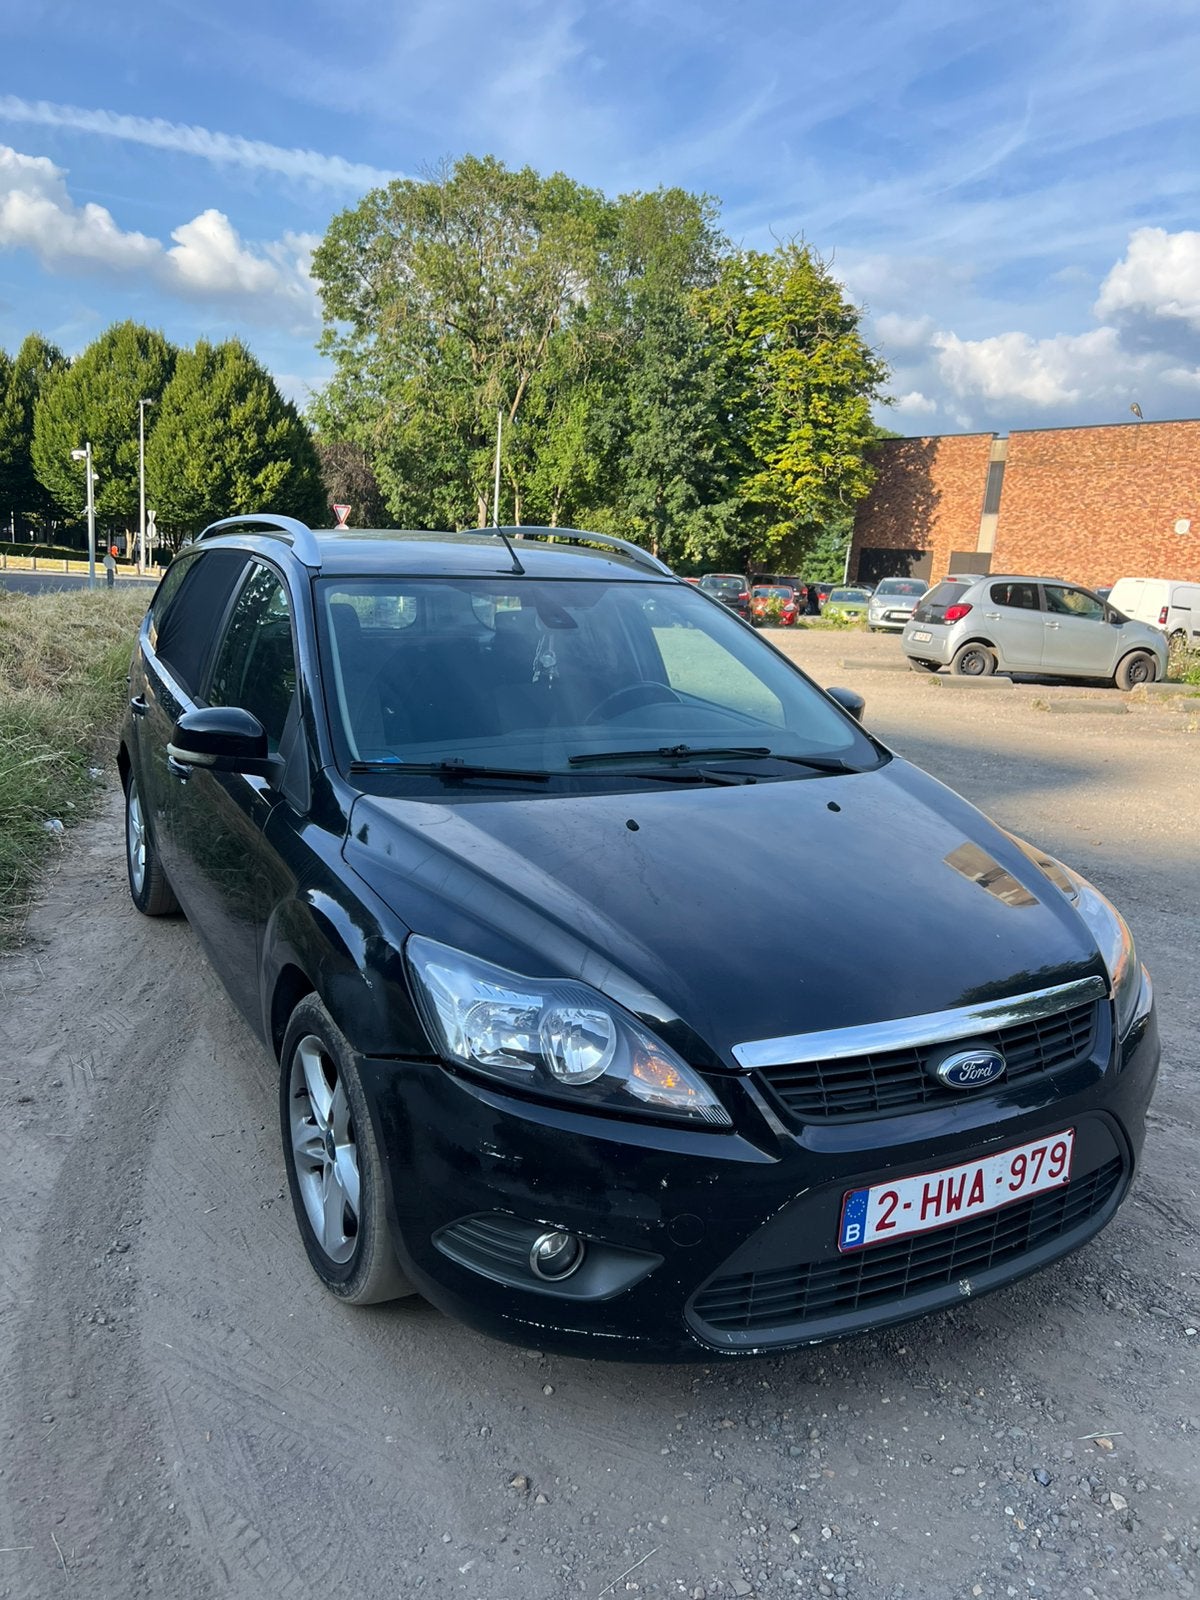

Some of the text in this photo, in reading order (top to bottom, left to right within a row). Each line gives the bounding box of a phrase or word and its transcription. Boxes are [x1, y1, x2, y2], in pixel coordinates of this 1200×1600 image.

[959, 1059, 994, 1081] Ford
[875, 1141, 1068, 1232] 2-HWA-979
[845, 1223, 860, 1243] B
